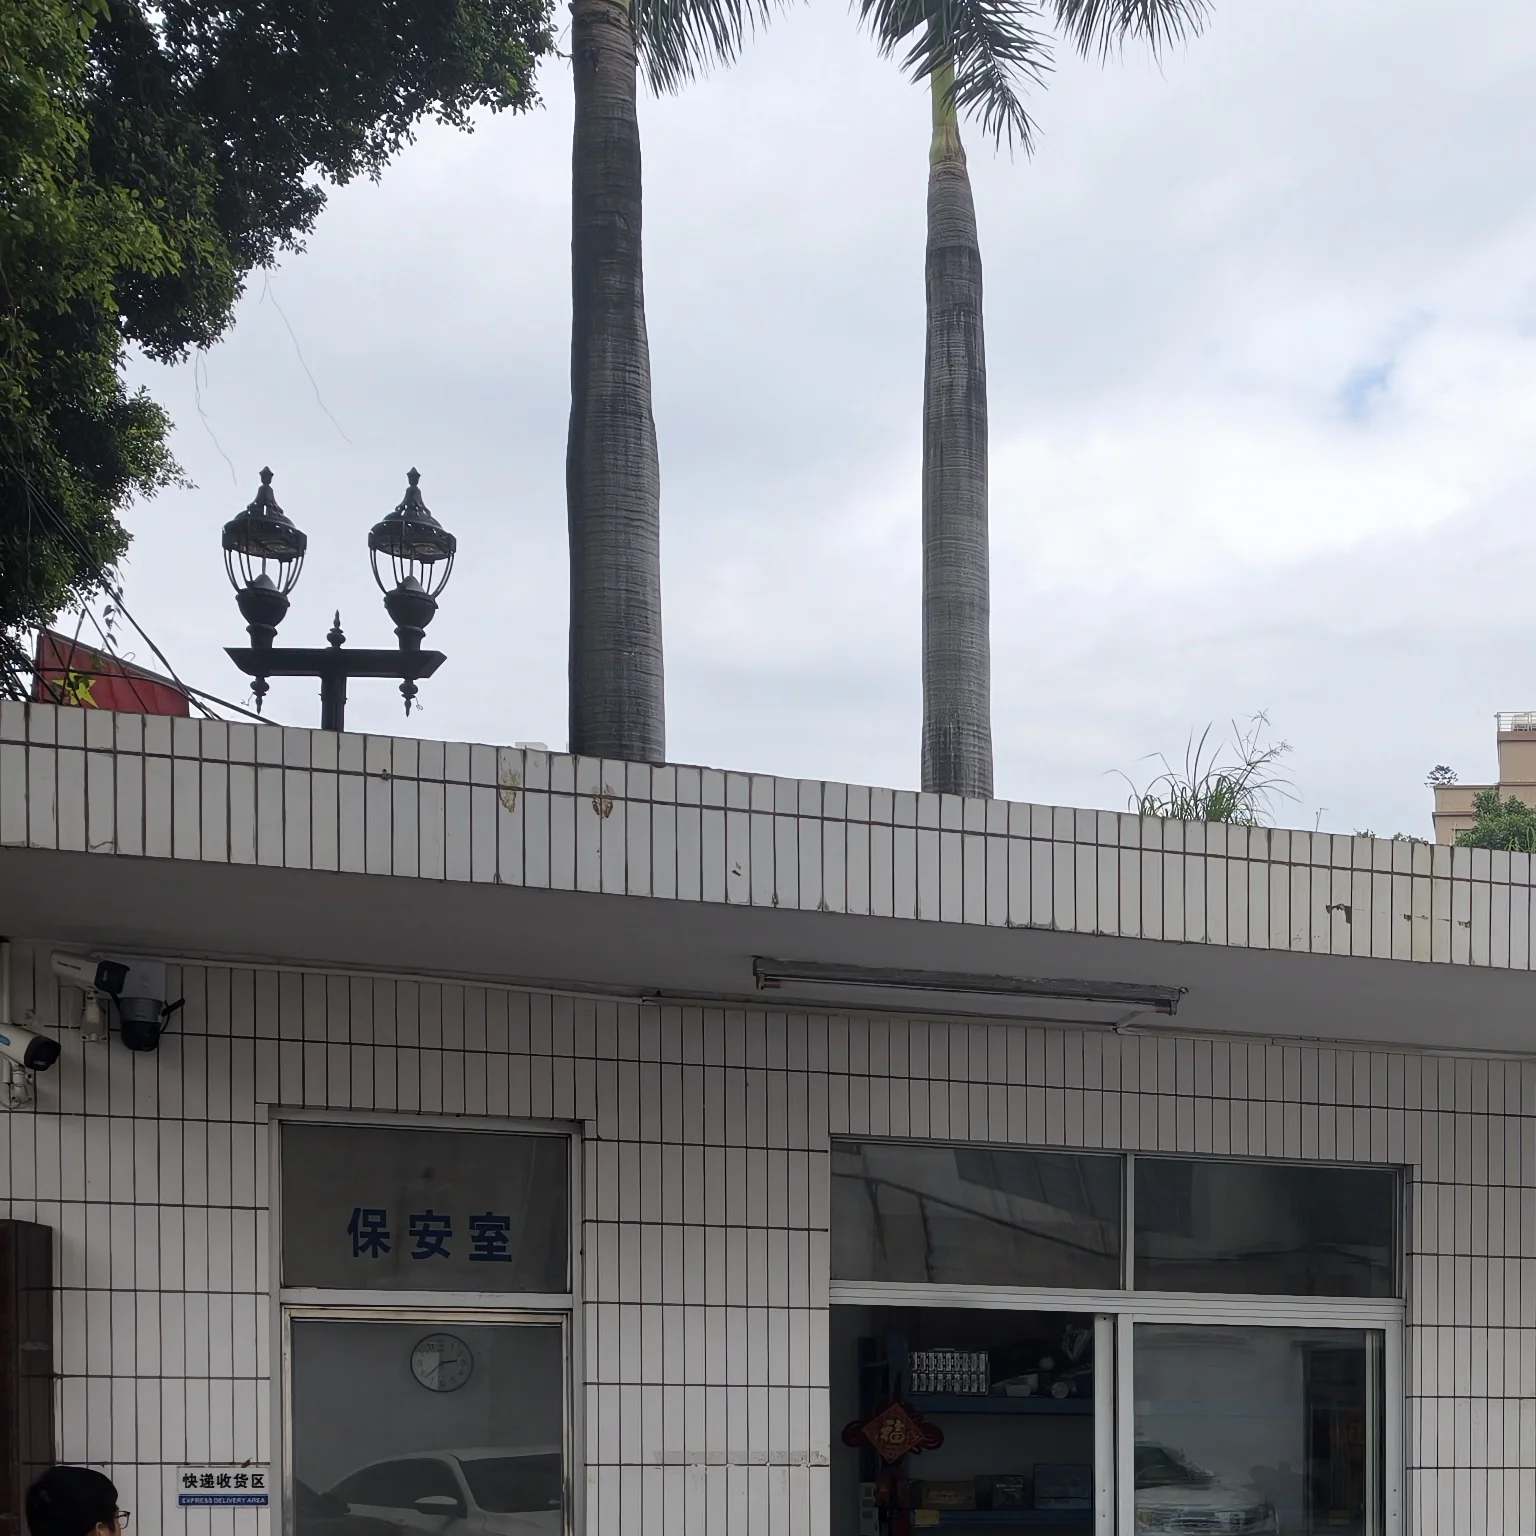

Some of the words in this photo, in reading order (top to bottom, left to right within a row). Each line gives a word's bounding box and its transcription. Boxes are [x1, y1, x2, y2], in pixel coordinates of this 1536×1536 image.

[347, 1207, 512, 1262] 保安室
[881, 1418, 905, 1443] 福
[182, 1472, 265, 1489] 快递收货区
